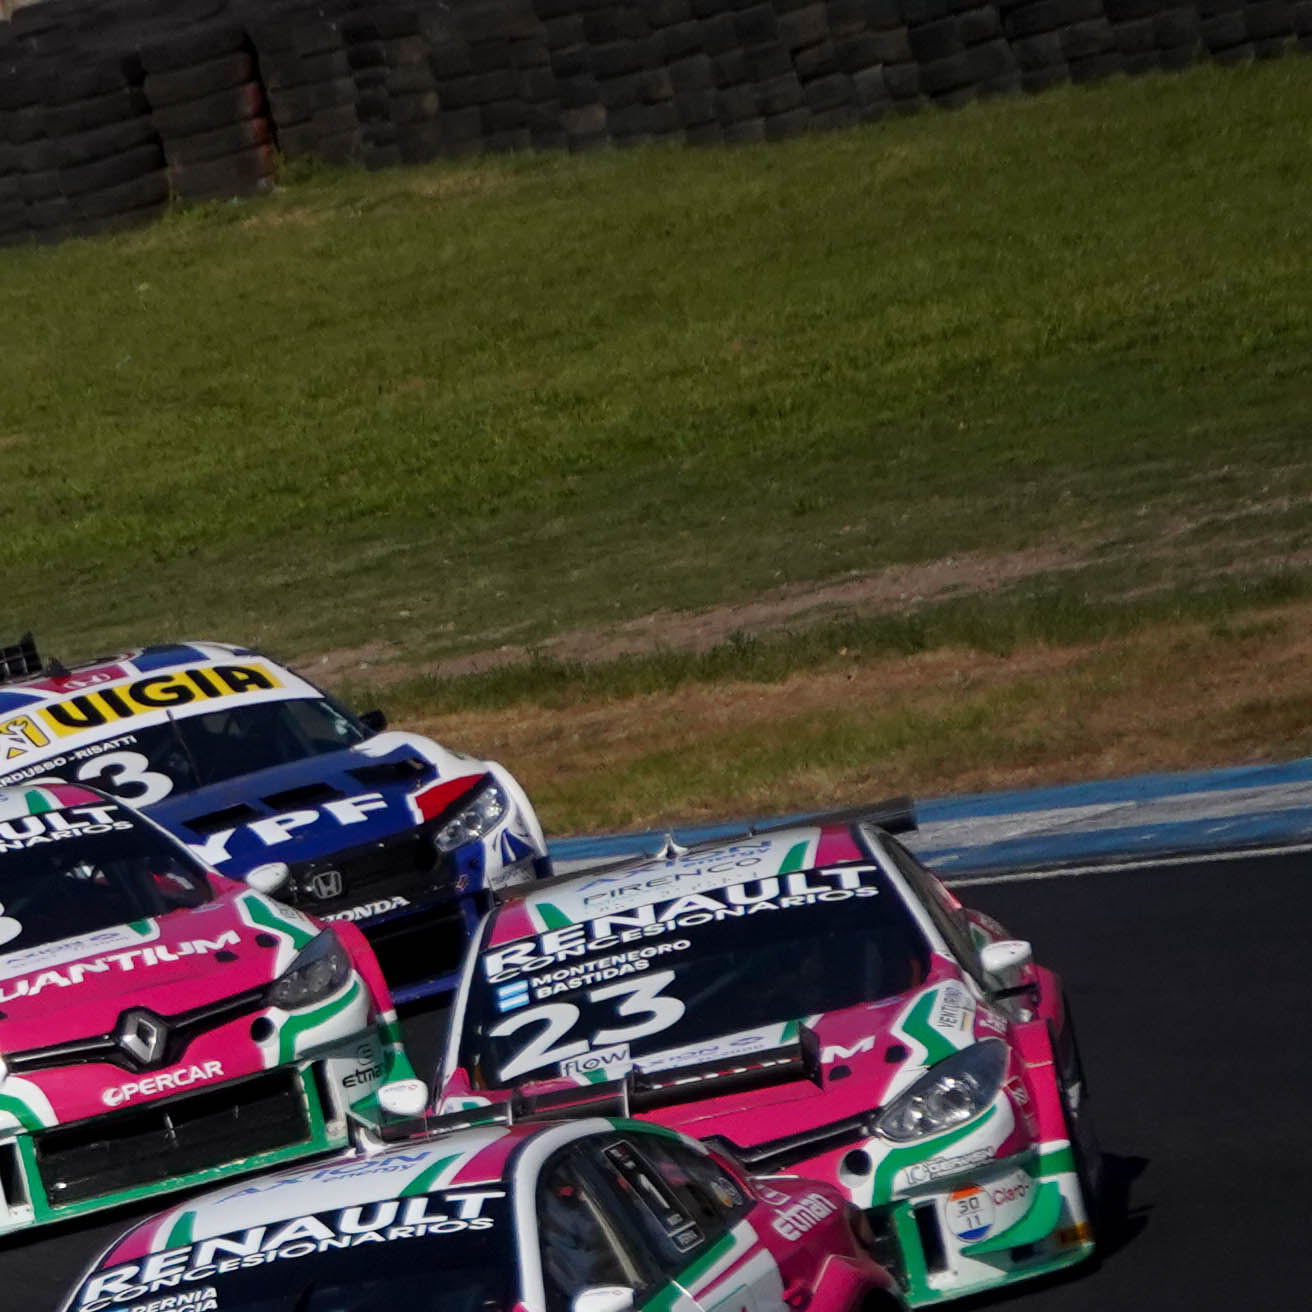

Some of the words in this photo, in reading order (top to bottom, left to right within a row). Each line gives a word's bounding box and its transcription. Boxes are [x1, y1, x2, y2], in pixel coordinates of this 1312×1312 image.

[186, 793, 388, 866] YPF
[482, 865, 878, 975] RENAULT
[487, 885, 880, 984] CONCESIONARIOS
[532, 938, 692, 987] MONTENEGRO
[489, 970, 686, 1084] 23
[536, 958, 651, 1000] BASTIDAS
[81, 1190, 507, 1304] RENAULT
